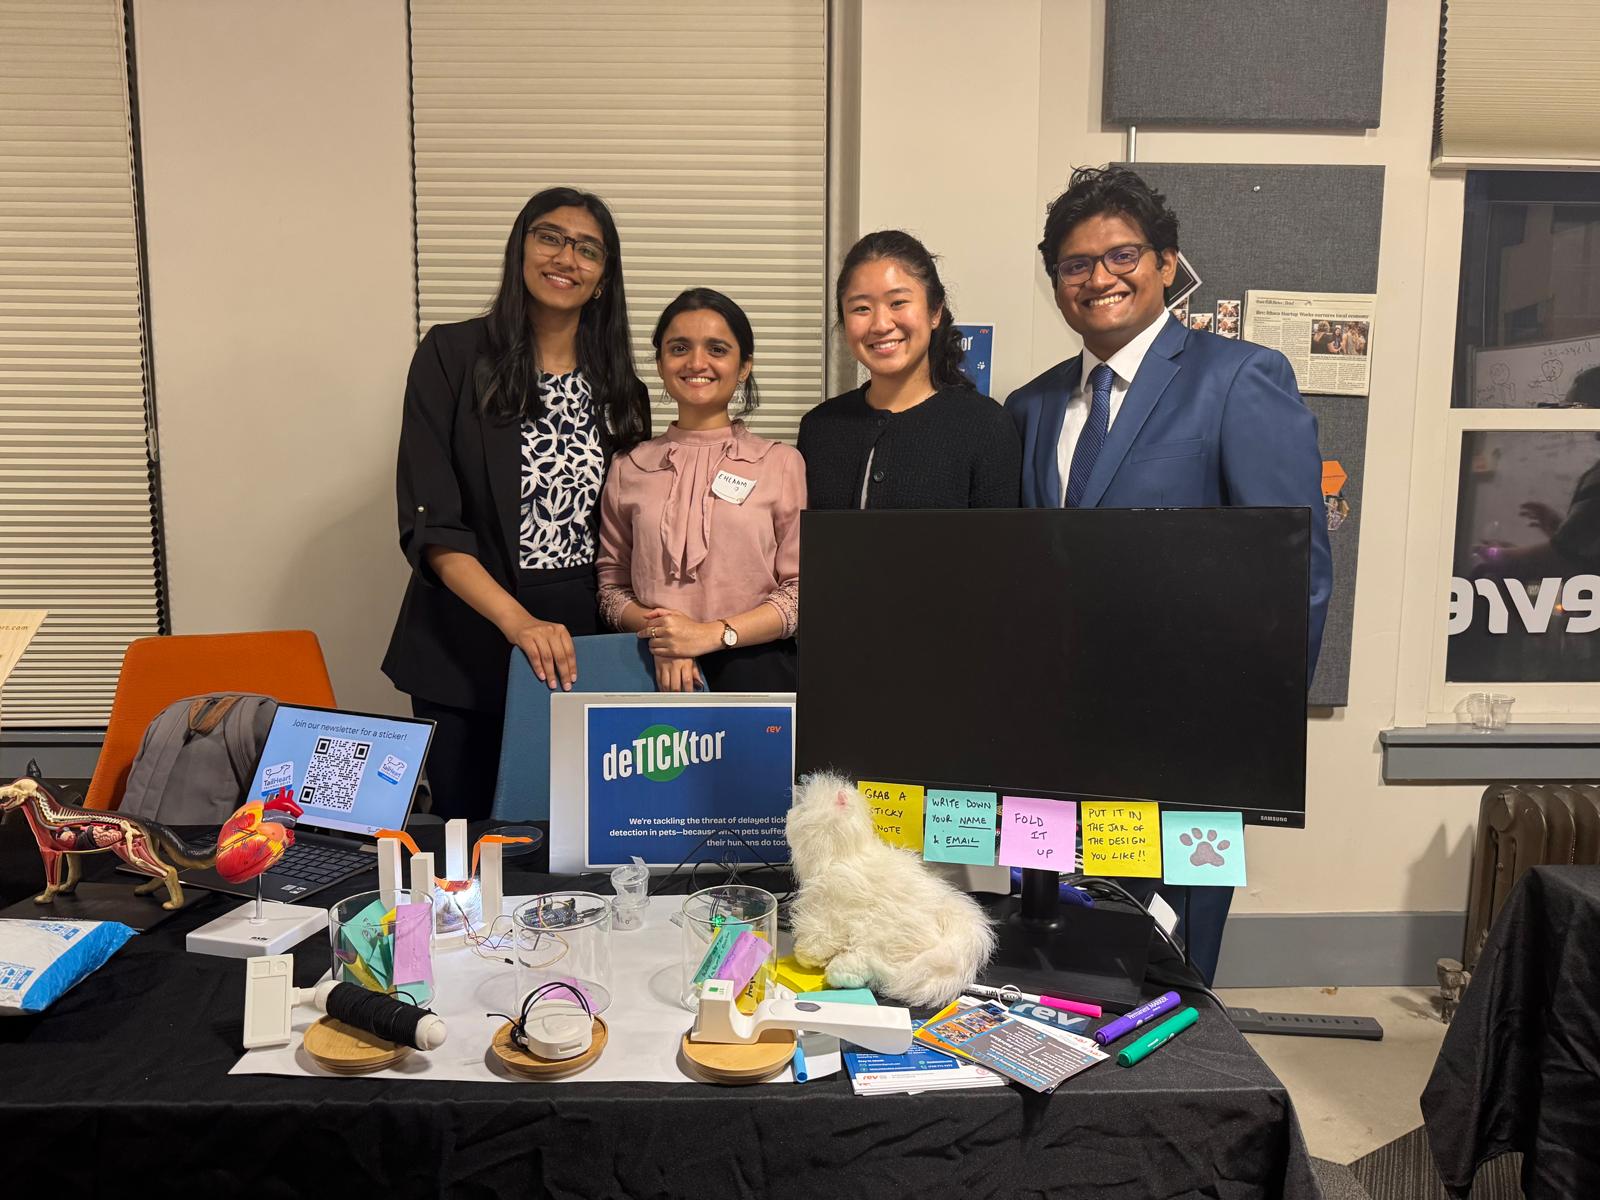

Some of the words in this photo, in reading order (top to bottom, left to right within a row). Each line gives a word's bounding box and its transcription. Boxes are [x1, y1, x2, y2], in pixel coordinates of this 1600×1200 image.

[292, 720, 307, 728] Join
[320, 722, 359, 735] newsletter
[360, 728, 374, 736] for
[378, 730, 408, 741] sticker!
[766, 725, 782, 734] rev
[602, 730, 726, 782] deTICKtor
[864, 788, 890, 800] GRAB
[898, 791, 907, 800] A
[932, 798, 960, 809] WRITE
[966, 799, 992, 810] DOWN
[932, 814, 952, 824] YOUR
[958, 816, 987, 825] NAME
[1088, 808, 1107, 818] PUT
[1112, 808, 1125, 818] IT
[1128, 810, 1142, 821] IN
[629, 817, 652, 825] We're
[653, 816, 686, 826] tackling
[686, 816, 700, 824] the
[738, 816, 770, 825] delayed
[771, 816, 786, 824] tick
[1014, 812, 1044, 828] FOLD
[1086, 822, 1104, 832] THE
[1108, 823, 1128, 832] JAR
[609, 828, 648, 837] detection
[741, 828, 760, 836] pets
[1030, 830, 1048, 840] IT
[706, 838, 726, 846] their
[945, 836, 980, 845] EMAIL
[1088, 837, 1104, 846] THE
[1108, 836, 1146, 846] DESIGN
[1036, 848, 1054, 859] UP
[1091, 851, 1107, 861] YOU
[1014, 1003, 1086, 1026] rev
